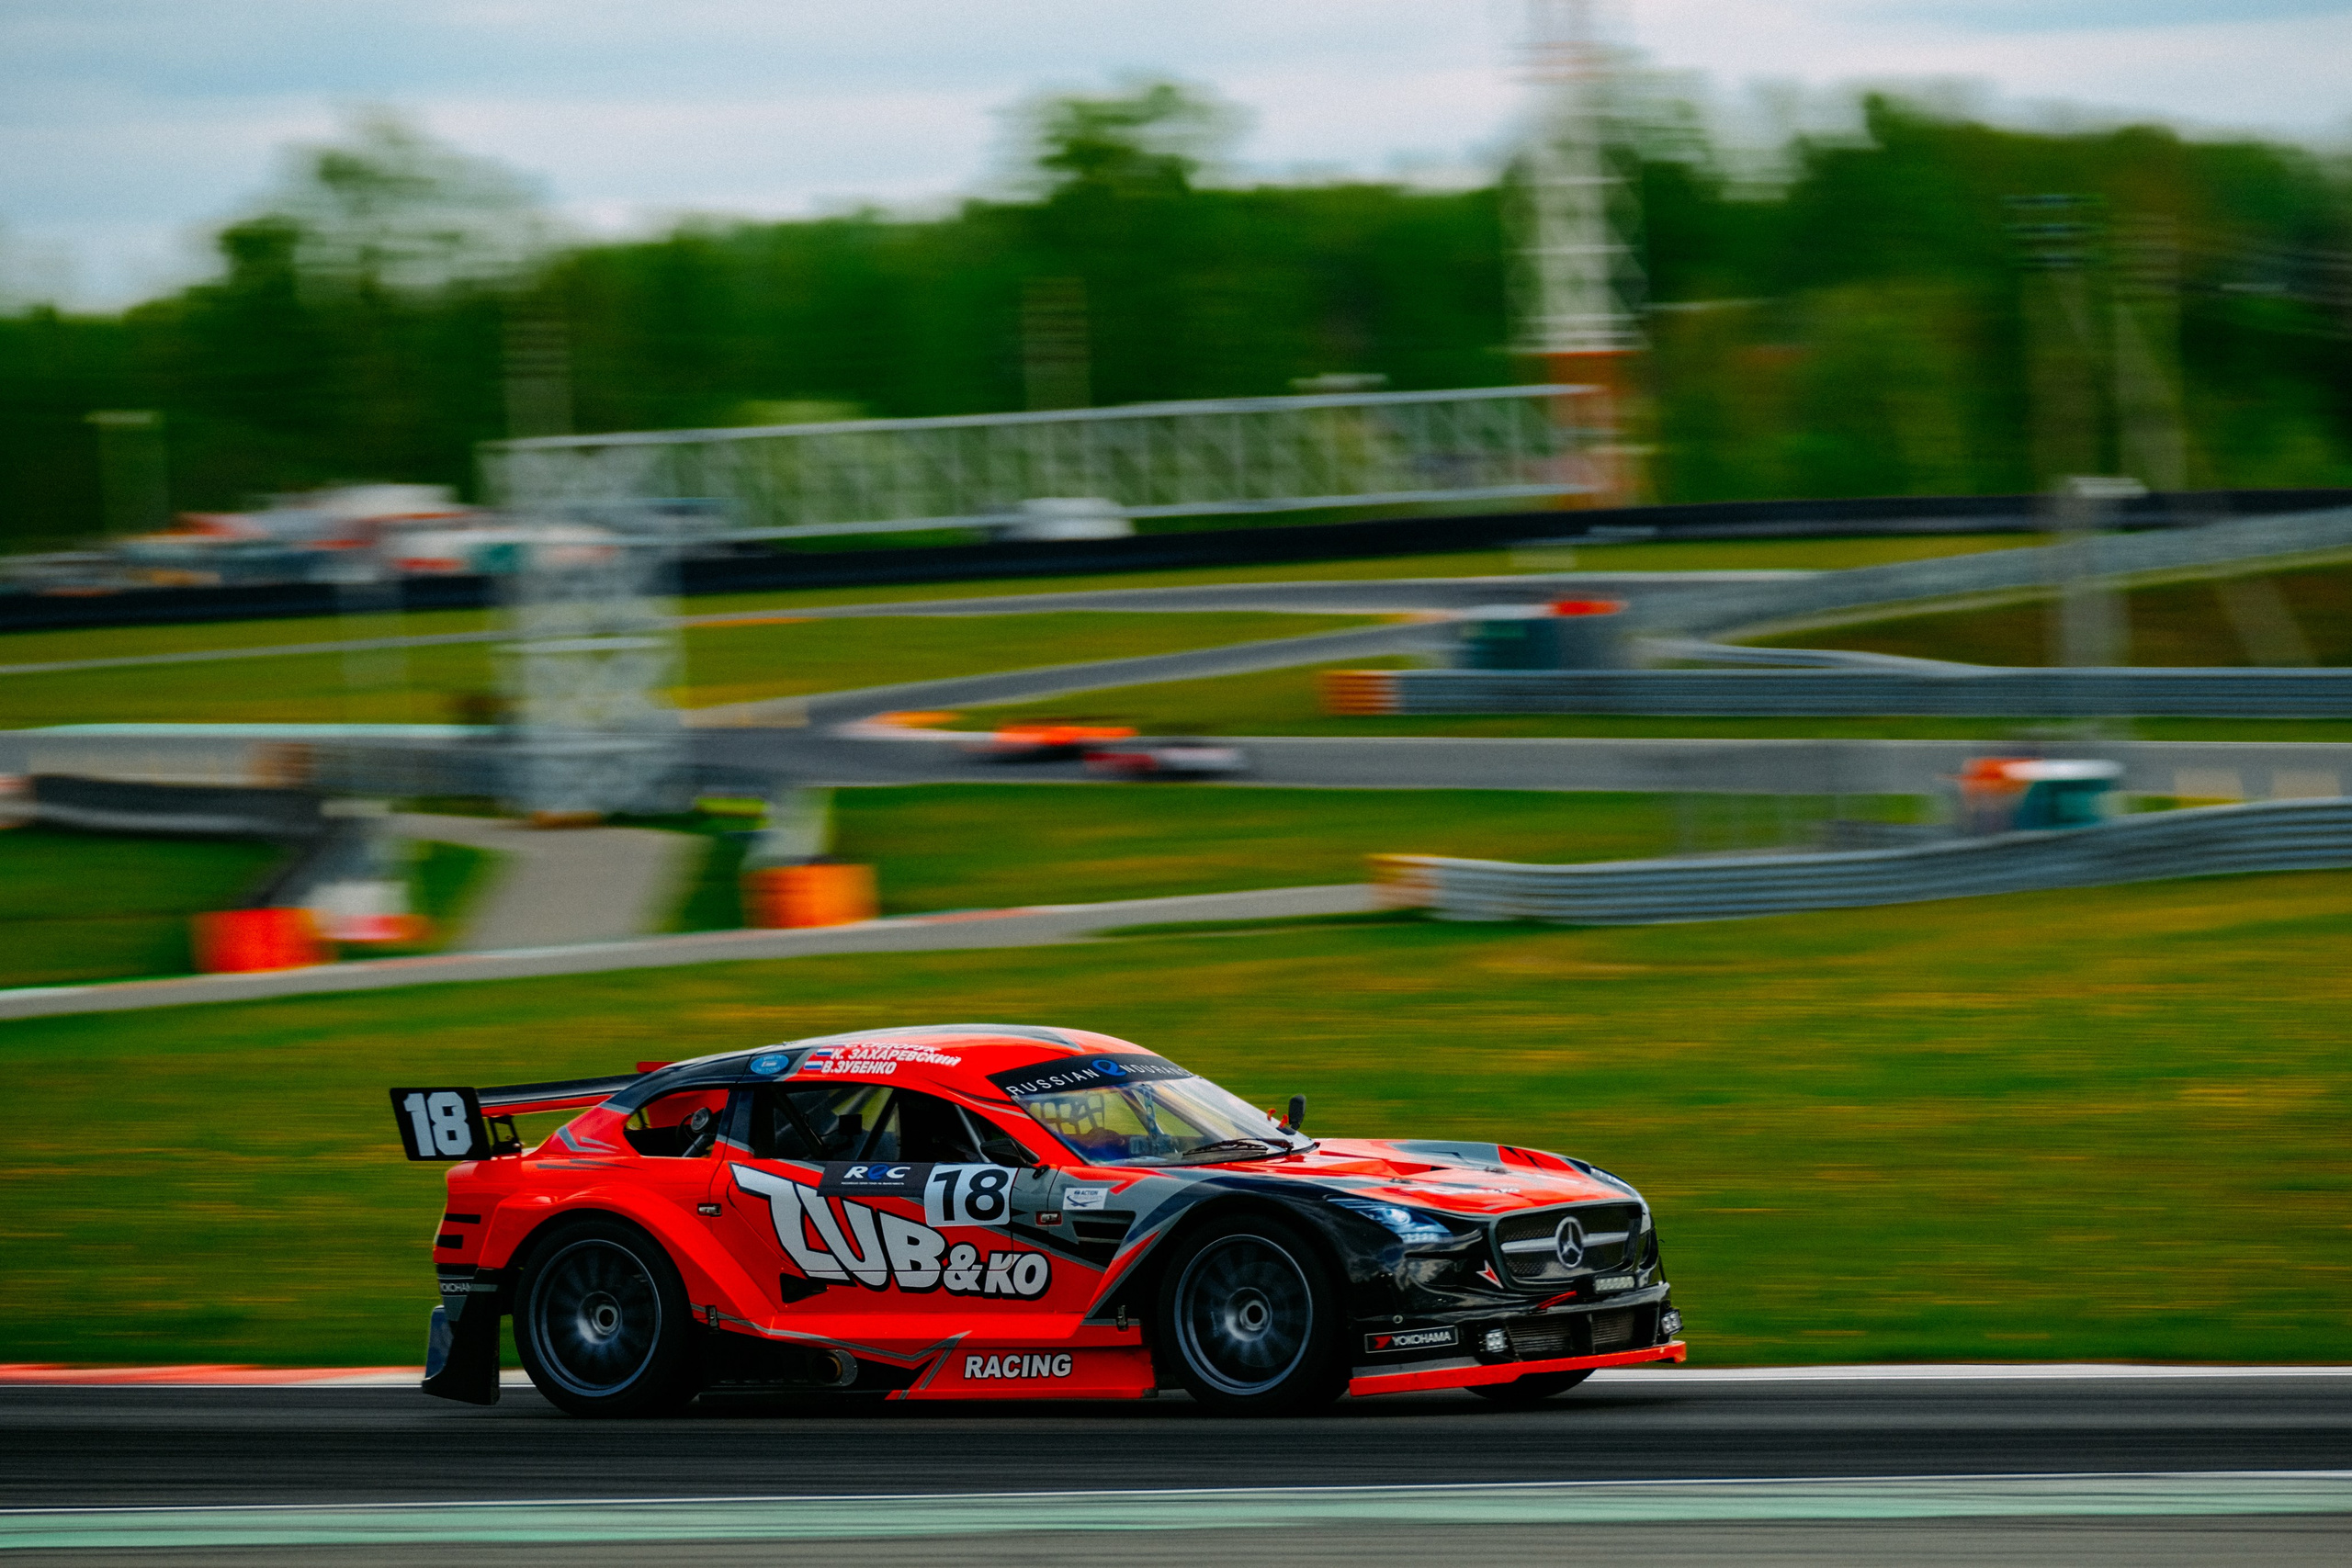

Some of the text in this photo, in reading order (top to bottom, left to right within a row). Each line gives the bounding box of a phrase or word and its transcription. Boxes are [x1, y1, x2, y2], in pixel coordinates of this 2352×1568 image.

[848, 1048, 962, 1067] ЗАХАРЕВСКИЙ
[1005, 1068, 1100, 1097] RUSSIAN
[403, 1091, 473, 1156] 18
[933, 1168, 1009, 1222] 18
[1392, 1331, 1452, 1346] YOKOHAMA
[964, 1353, 1072, 1379] RACING
